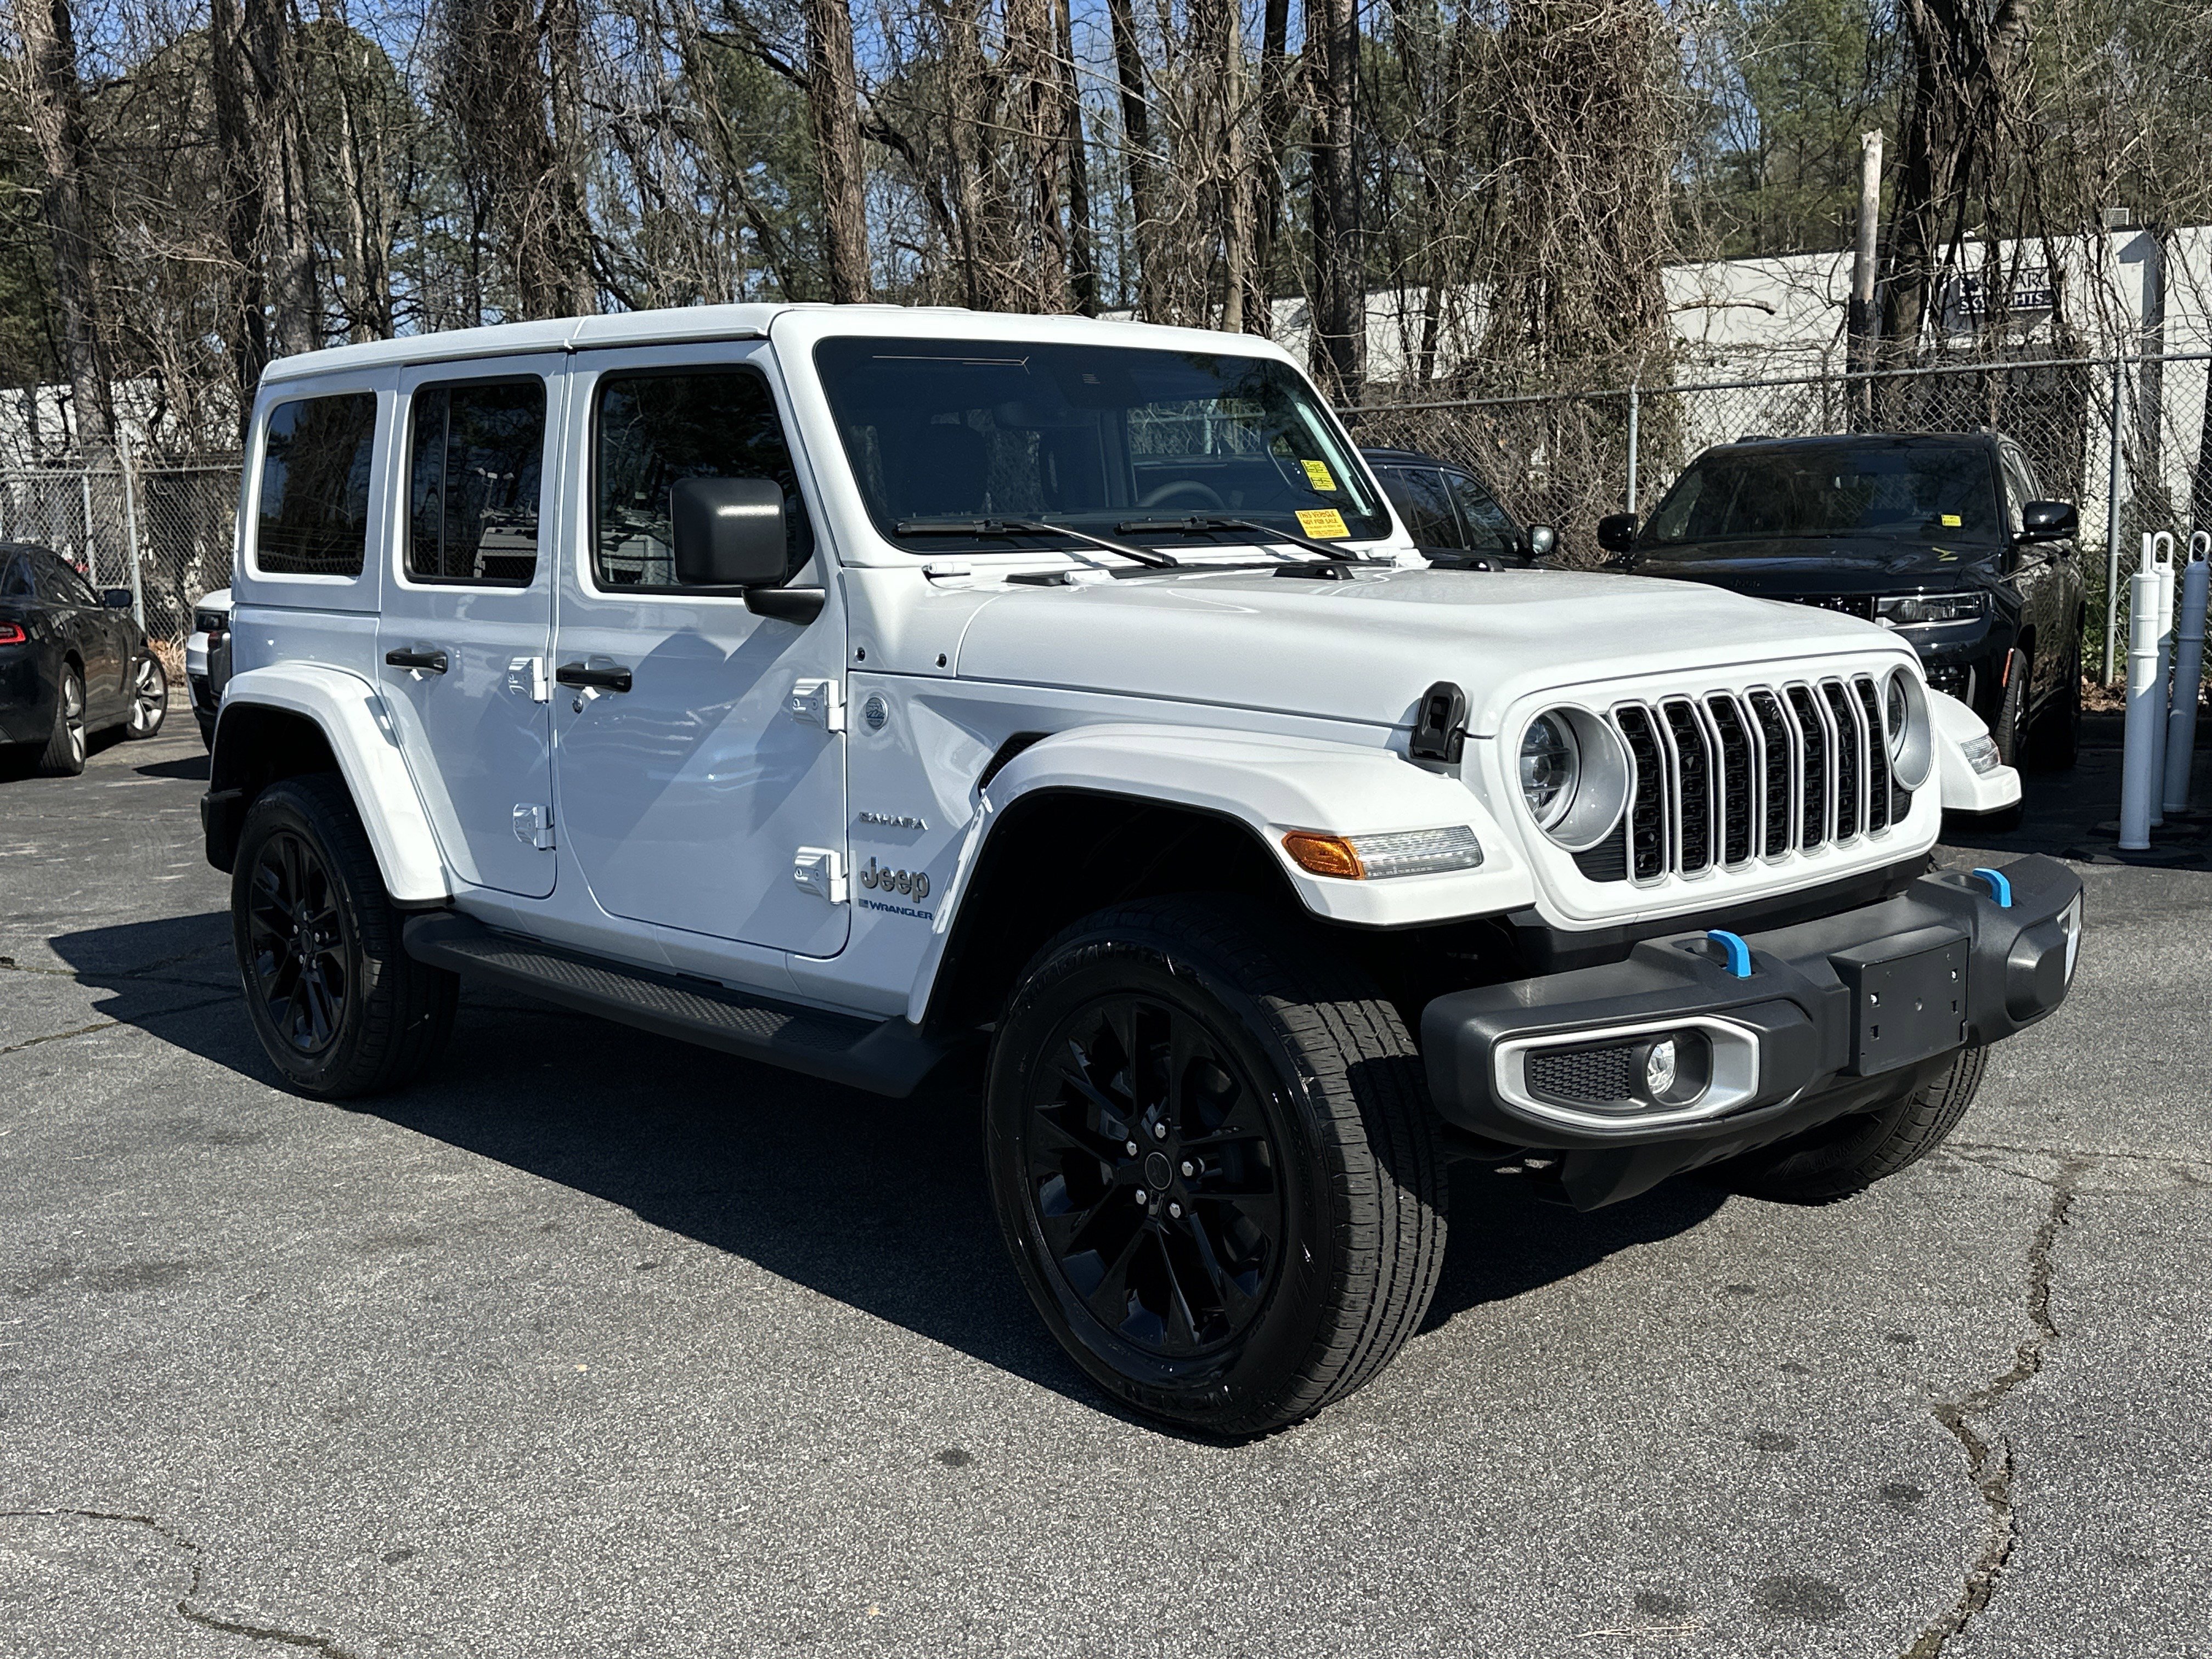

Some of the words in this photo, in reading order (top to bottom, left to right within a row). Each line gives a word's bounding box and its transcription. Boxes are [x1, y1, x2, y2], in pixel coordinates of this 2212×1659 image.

[859, 811, 928, 830] SAHARA
[860, 856, 930, 904] Jeep
[869, 900, 933, 920] WRANGLER
